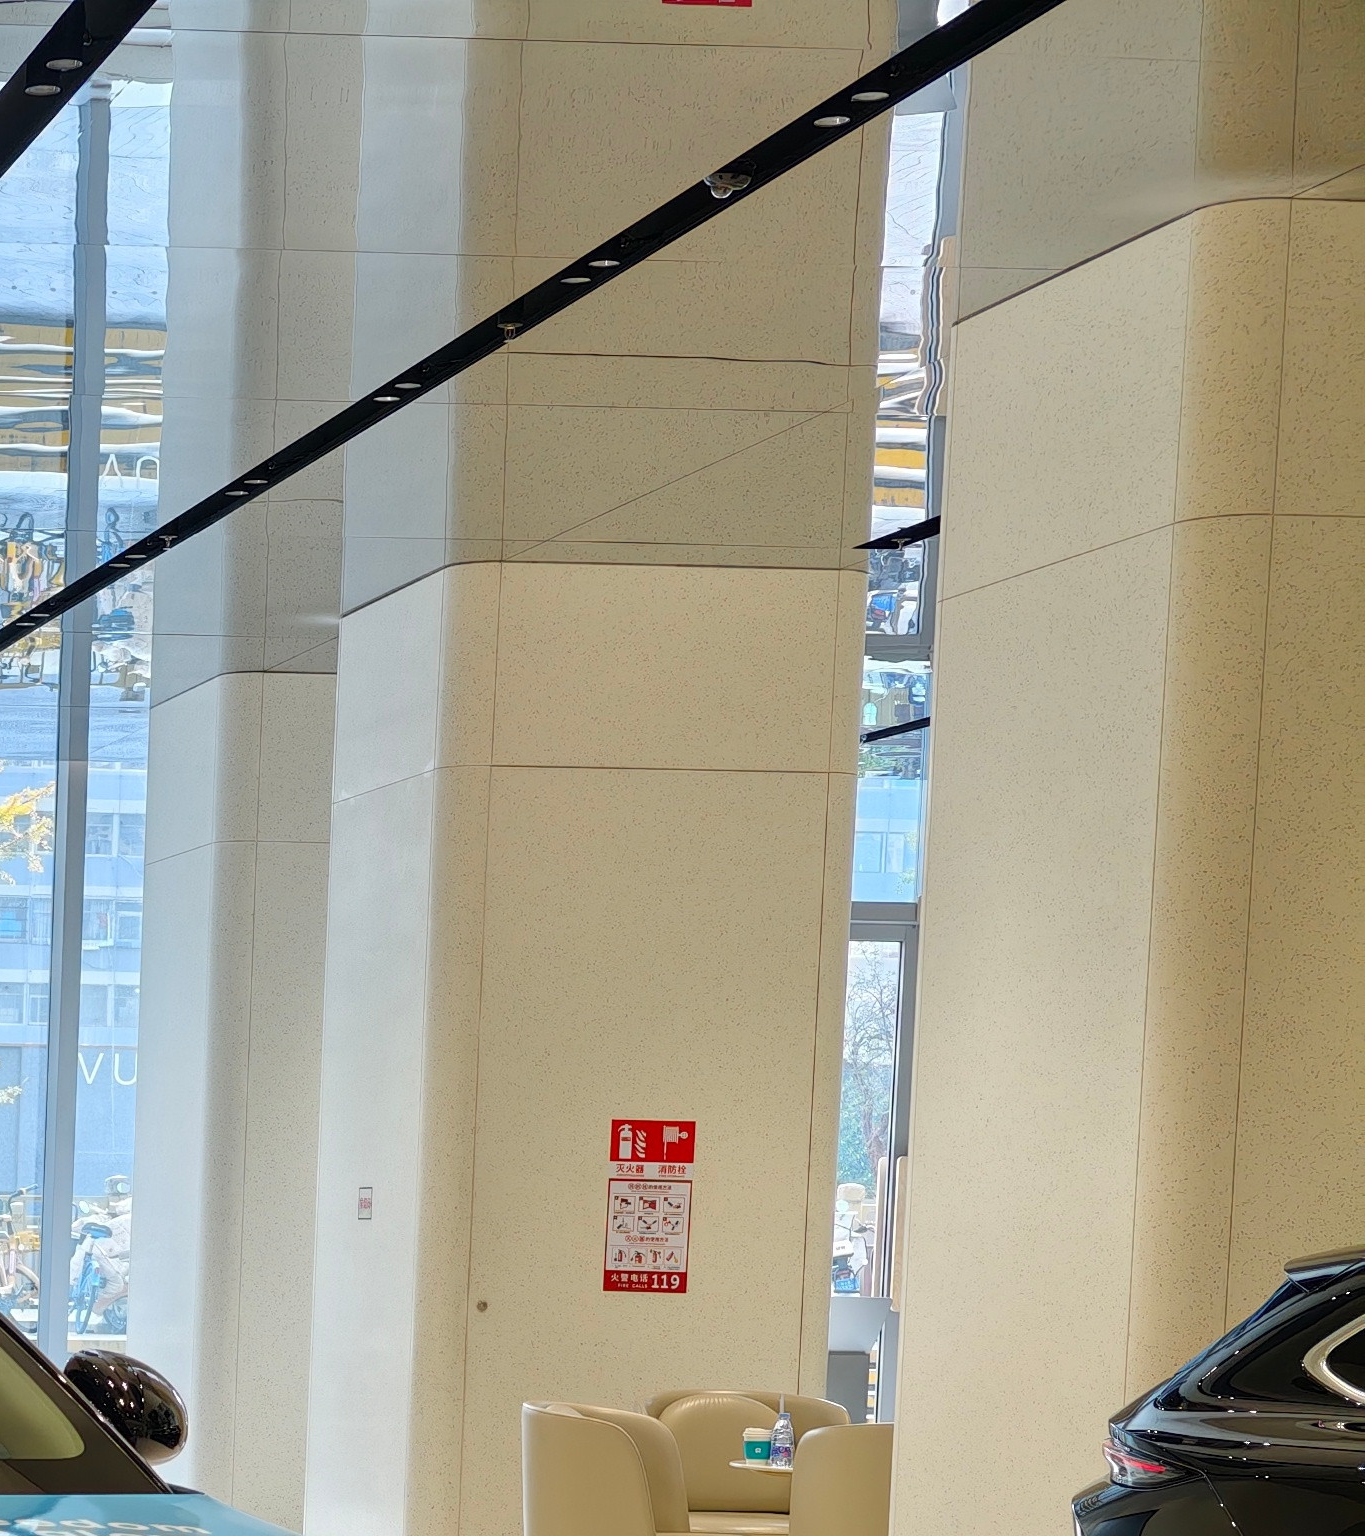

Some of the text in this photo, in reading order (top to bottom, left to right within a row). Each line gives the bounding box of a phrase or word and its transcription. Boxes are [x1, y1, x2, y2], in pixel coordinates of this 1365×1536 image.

[615, 1164, 645, 1174] 灭火器
[657, 1165, 687, 1175] 消防栓
[610, 1273, 680, 1289] 火警电话 119
